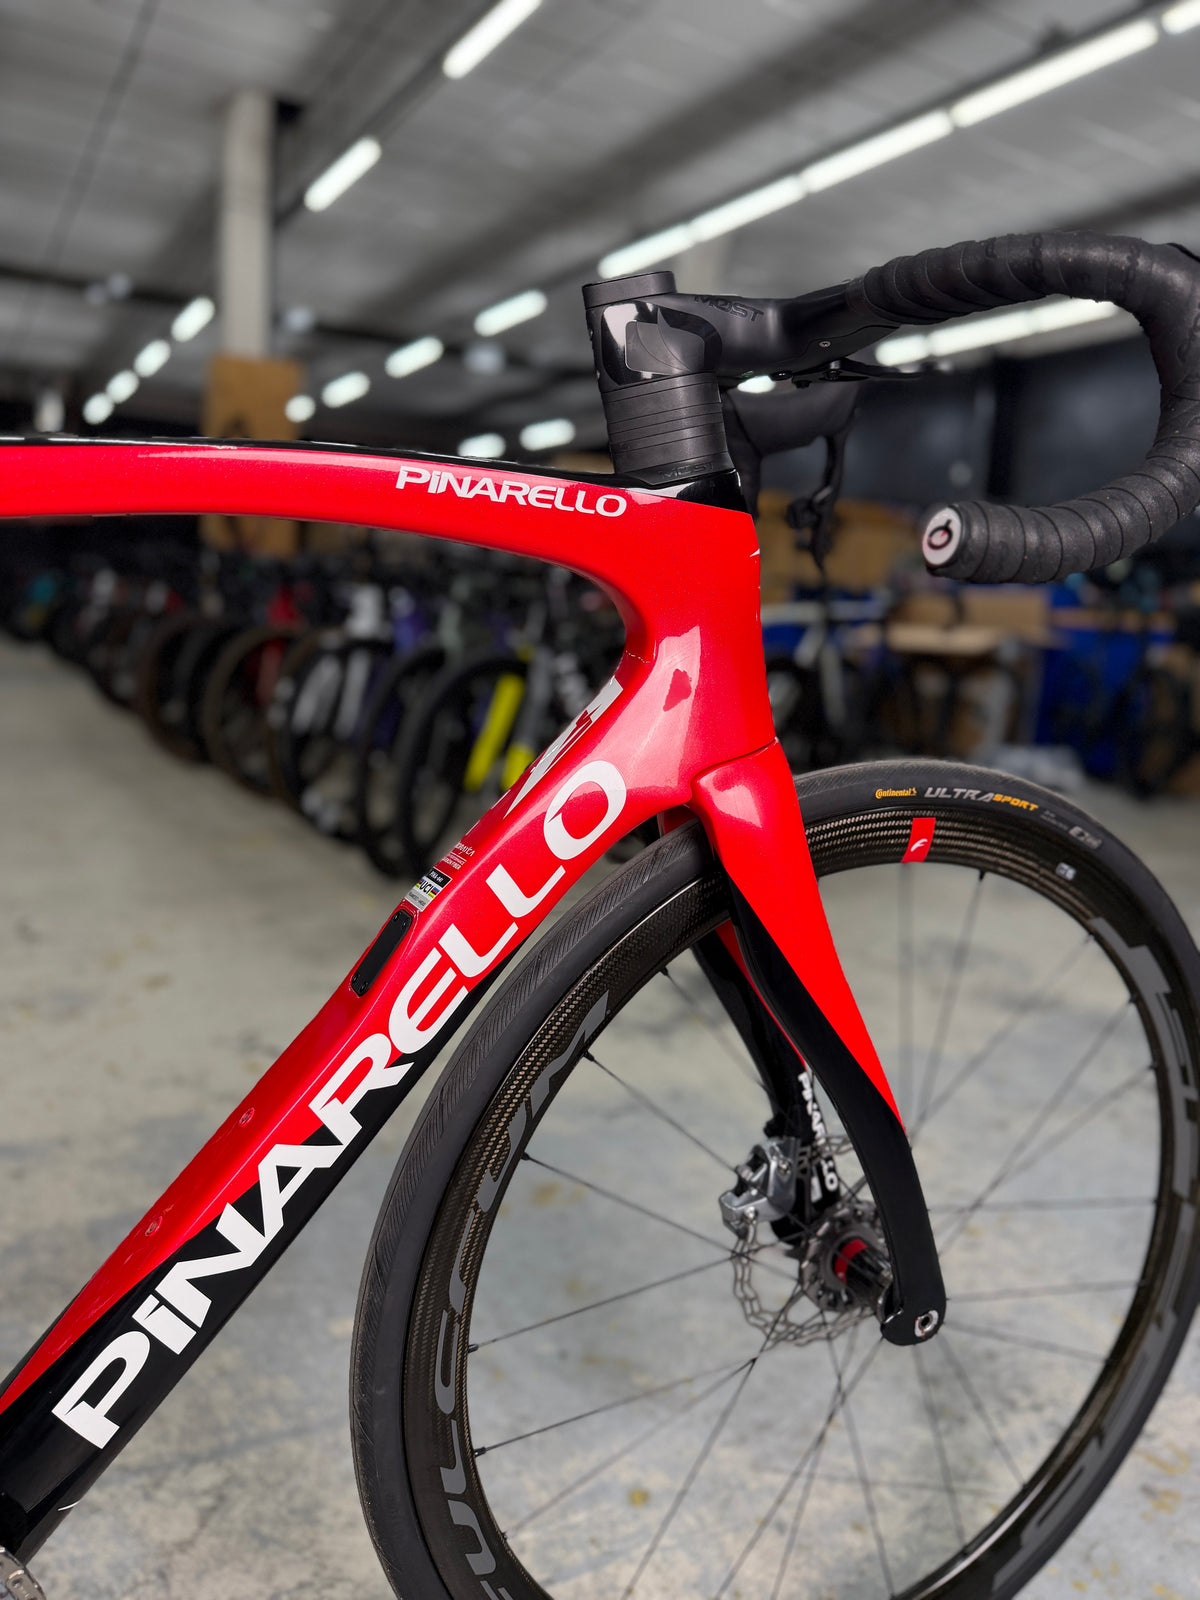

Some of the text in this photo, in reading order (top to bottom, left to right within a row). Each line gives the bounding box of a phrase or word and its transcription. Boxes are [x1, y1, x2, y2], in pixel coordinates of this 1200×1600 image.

[395, 465, 627, 517] PINARELLO
[875, 787, 911, 799] Continental
[419, 880, 434, 895] UCI
[51, 760, 627, 1449] PINARELLO
